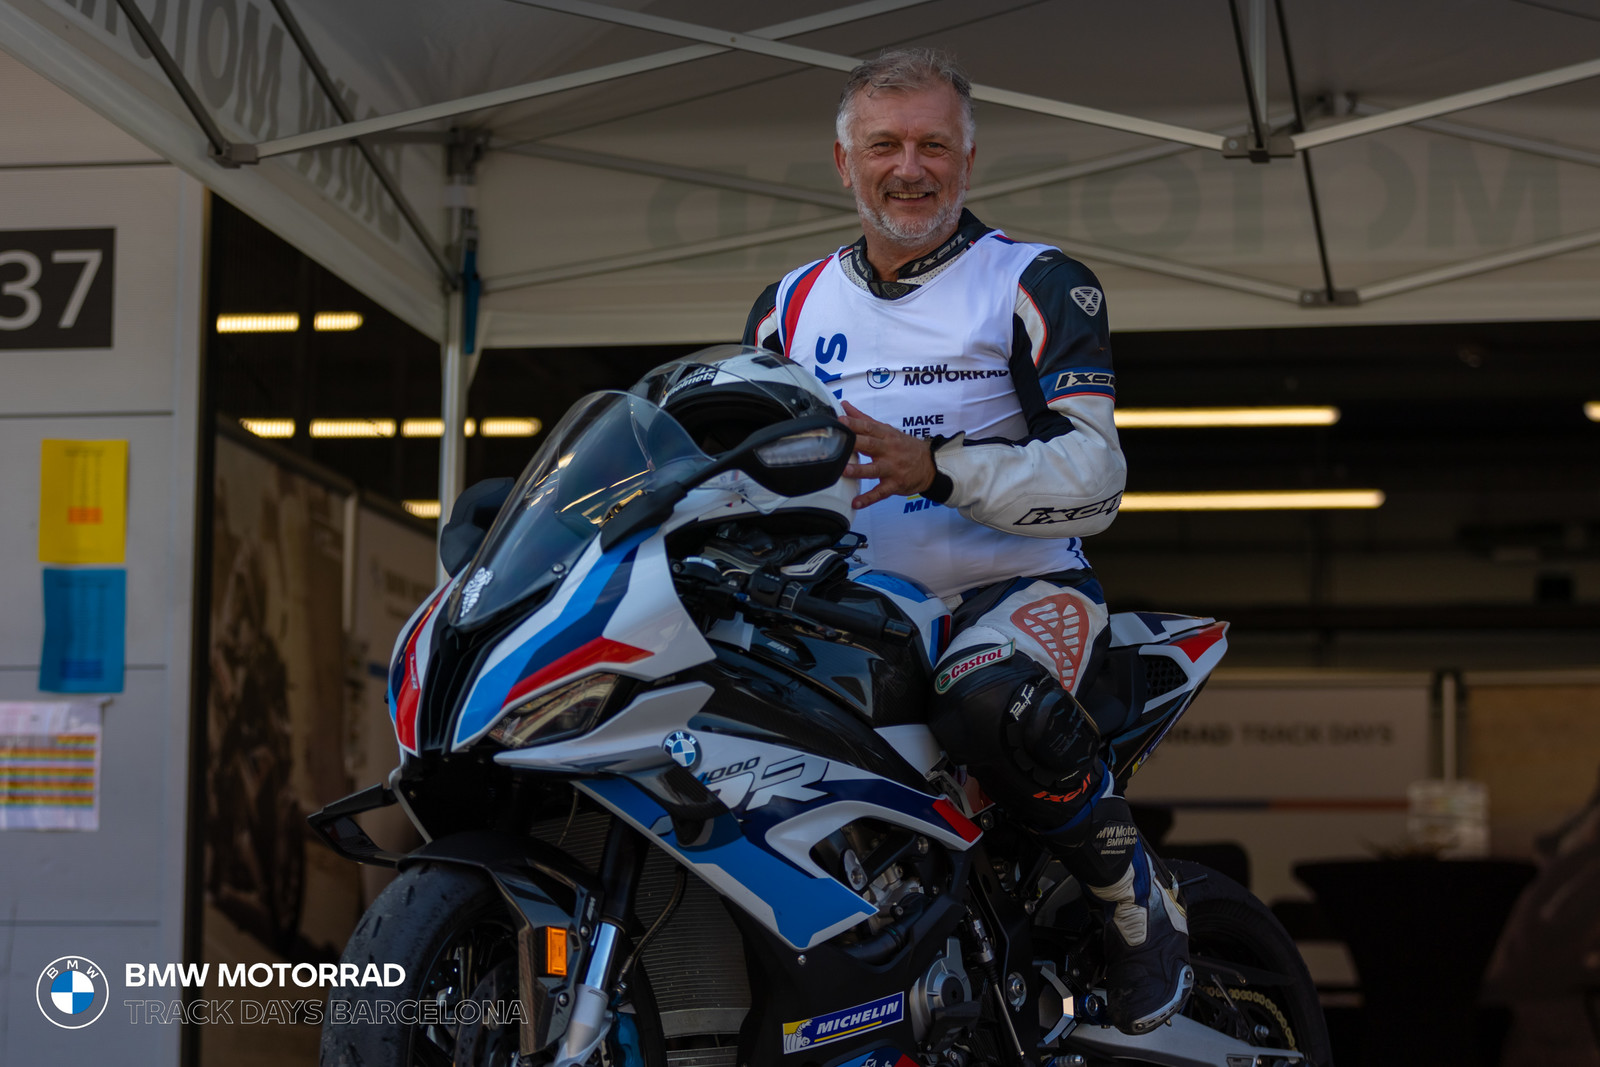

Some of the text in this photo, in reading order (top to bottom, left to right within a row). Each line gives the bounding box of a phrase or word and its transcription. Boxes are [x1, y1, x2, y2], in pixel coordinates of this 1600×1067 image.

[0, 249, 103, 331] 37
[815, 333, 848, 400] YS
[904, 370, 1009, 386] MOTORRAD
[903, 414, 944, 428] MAKE
[951, 648, 1003, 679] Castrol
[665, 731, 697, 748] BMW
[1116, 825, 1138, 838] Moto
[1106, 838, 1124, 847] BMW
[816, 1001, 900, 1036] MICHELIN
